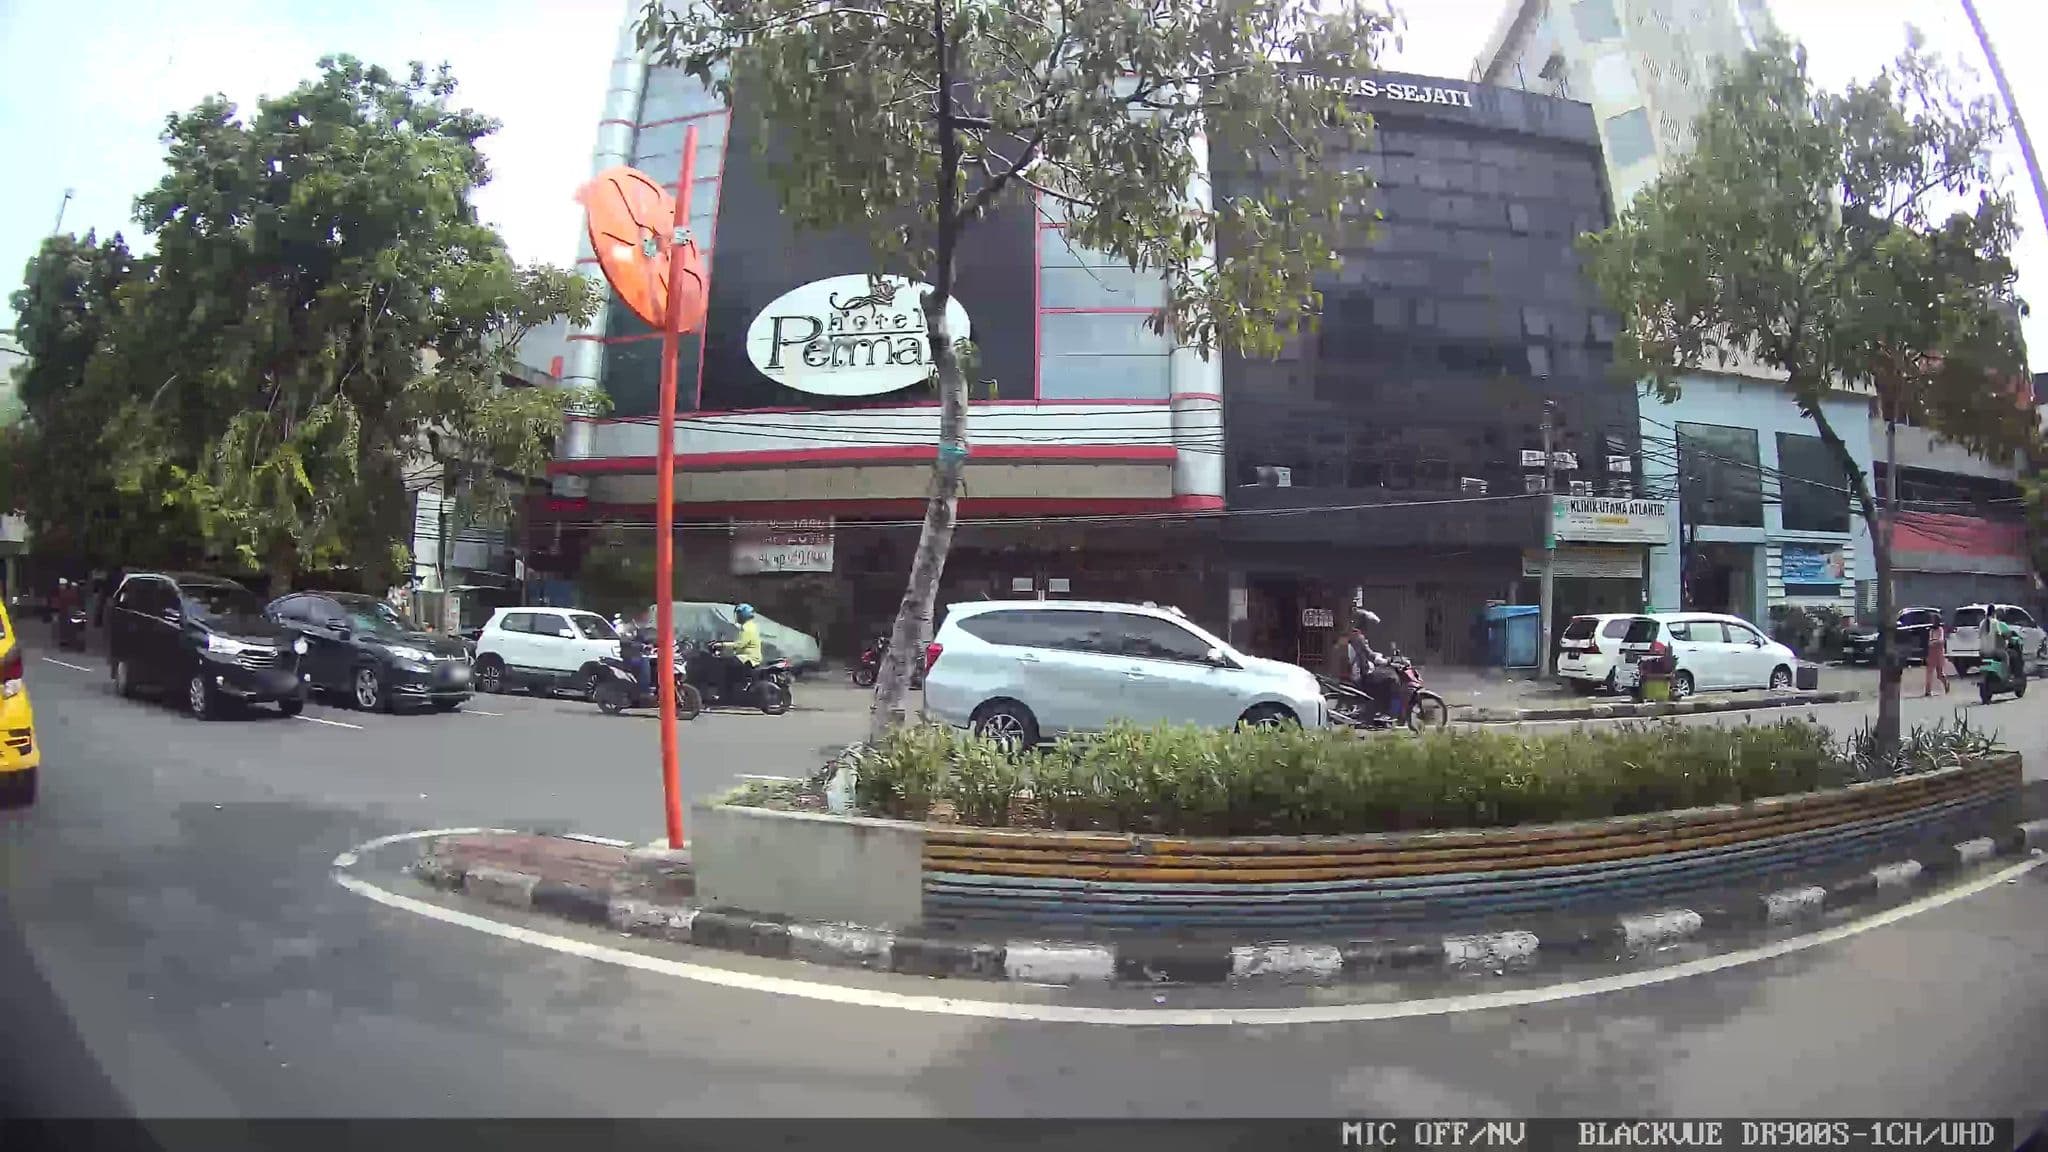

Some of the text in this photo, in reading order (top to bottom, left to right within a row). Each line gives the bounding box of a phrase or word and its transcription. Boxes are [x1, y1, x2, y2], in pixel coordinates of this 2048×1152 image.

[827, 308, 926, 331] hotel
[764, 315, 935, 367] Perma
[1570, 500, 1665, 516] KLINIK UTAMA ATLANTIC
